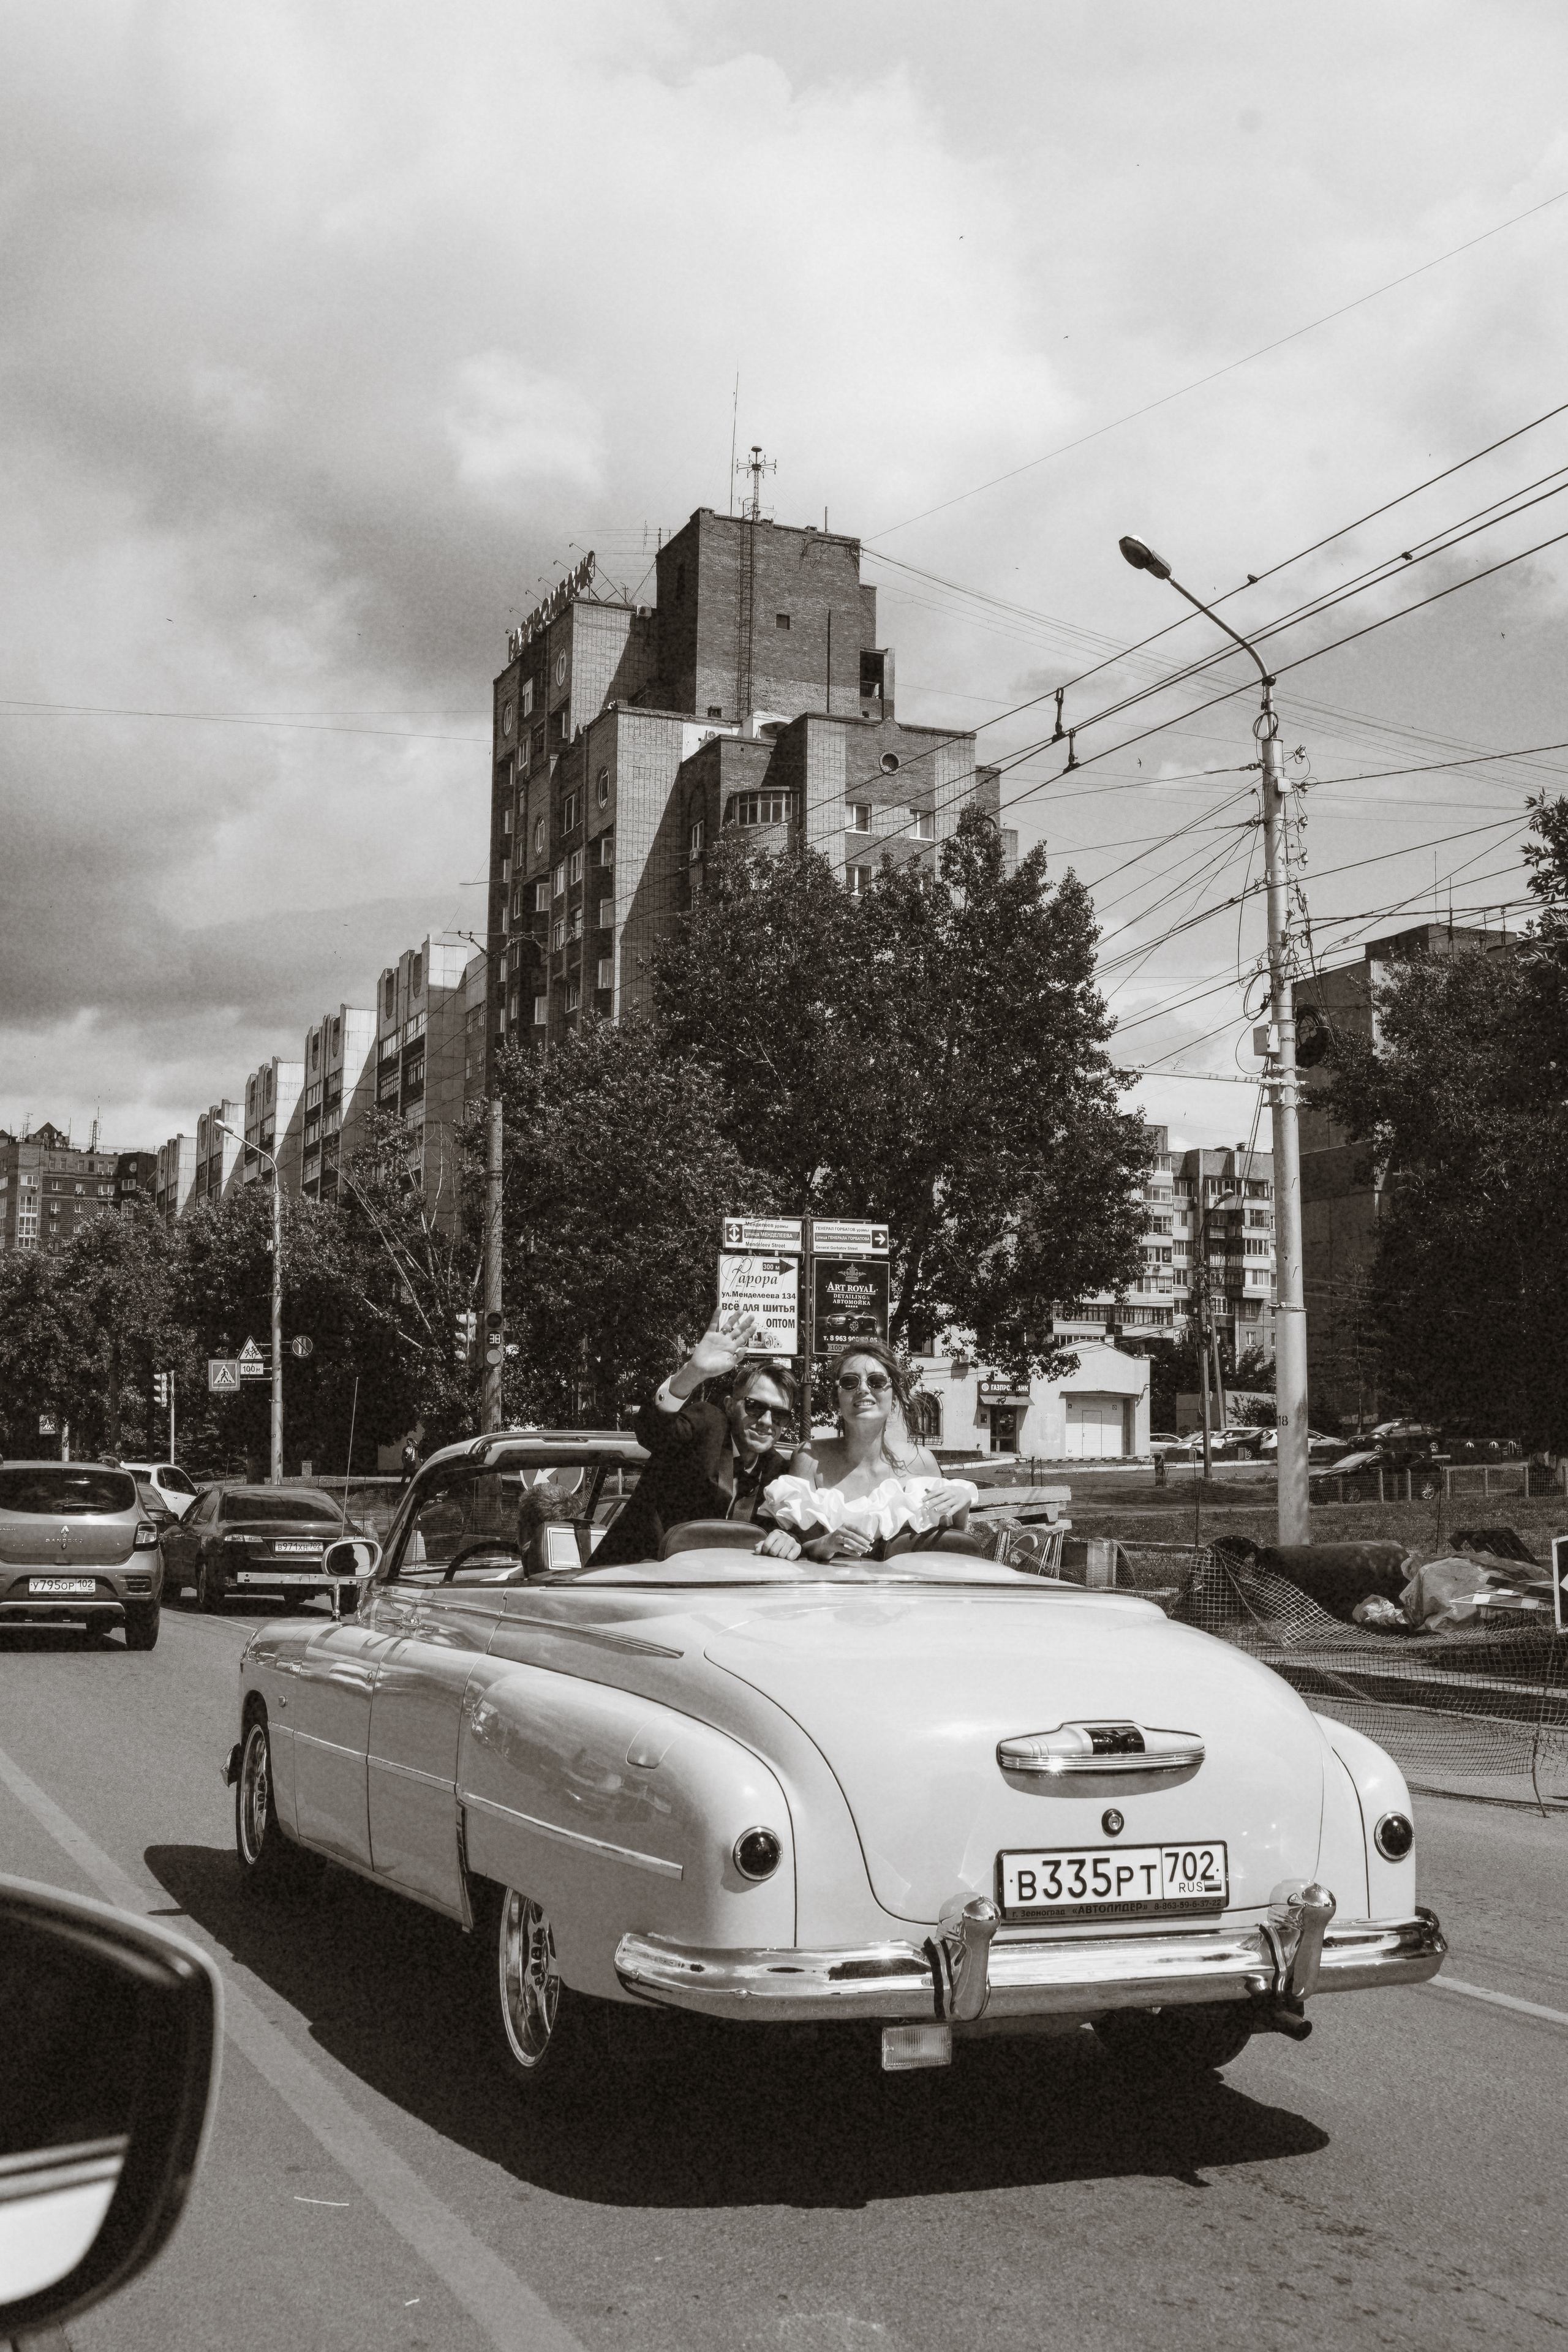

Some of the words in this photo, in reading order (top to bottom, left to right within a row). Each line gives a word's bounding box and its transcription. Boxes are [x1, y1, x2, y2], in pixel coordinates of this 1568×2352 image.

[827, 1281, 846, 1292] ART
[742, 1303, 760, 1313] для
[763, 1304, 795, 1313] шитья
[489, 1333, 500, 1344] 38
[33, 1579, 75, 1590] У795ОР
[77, 1579, 93, 1588] 102
[1017, 1856, 1157, 1901] В335РТ
[1164, 1850, 1215, 1883] 702
[1178, 1881, 1204, 1894] RUS
[1020, 1908, 1066, 1918] Зерноград
[1072, 1902, 1148, 1915] «АВТОЛИДЕР»
[1154, 1899, 1222, 1910] 8-863-59-6-37-22
